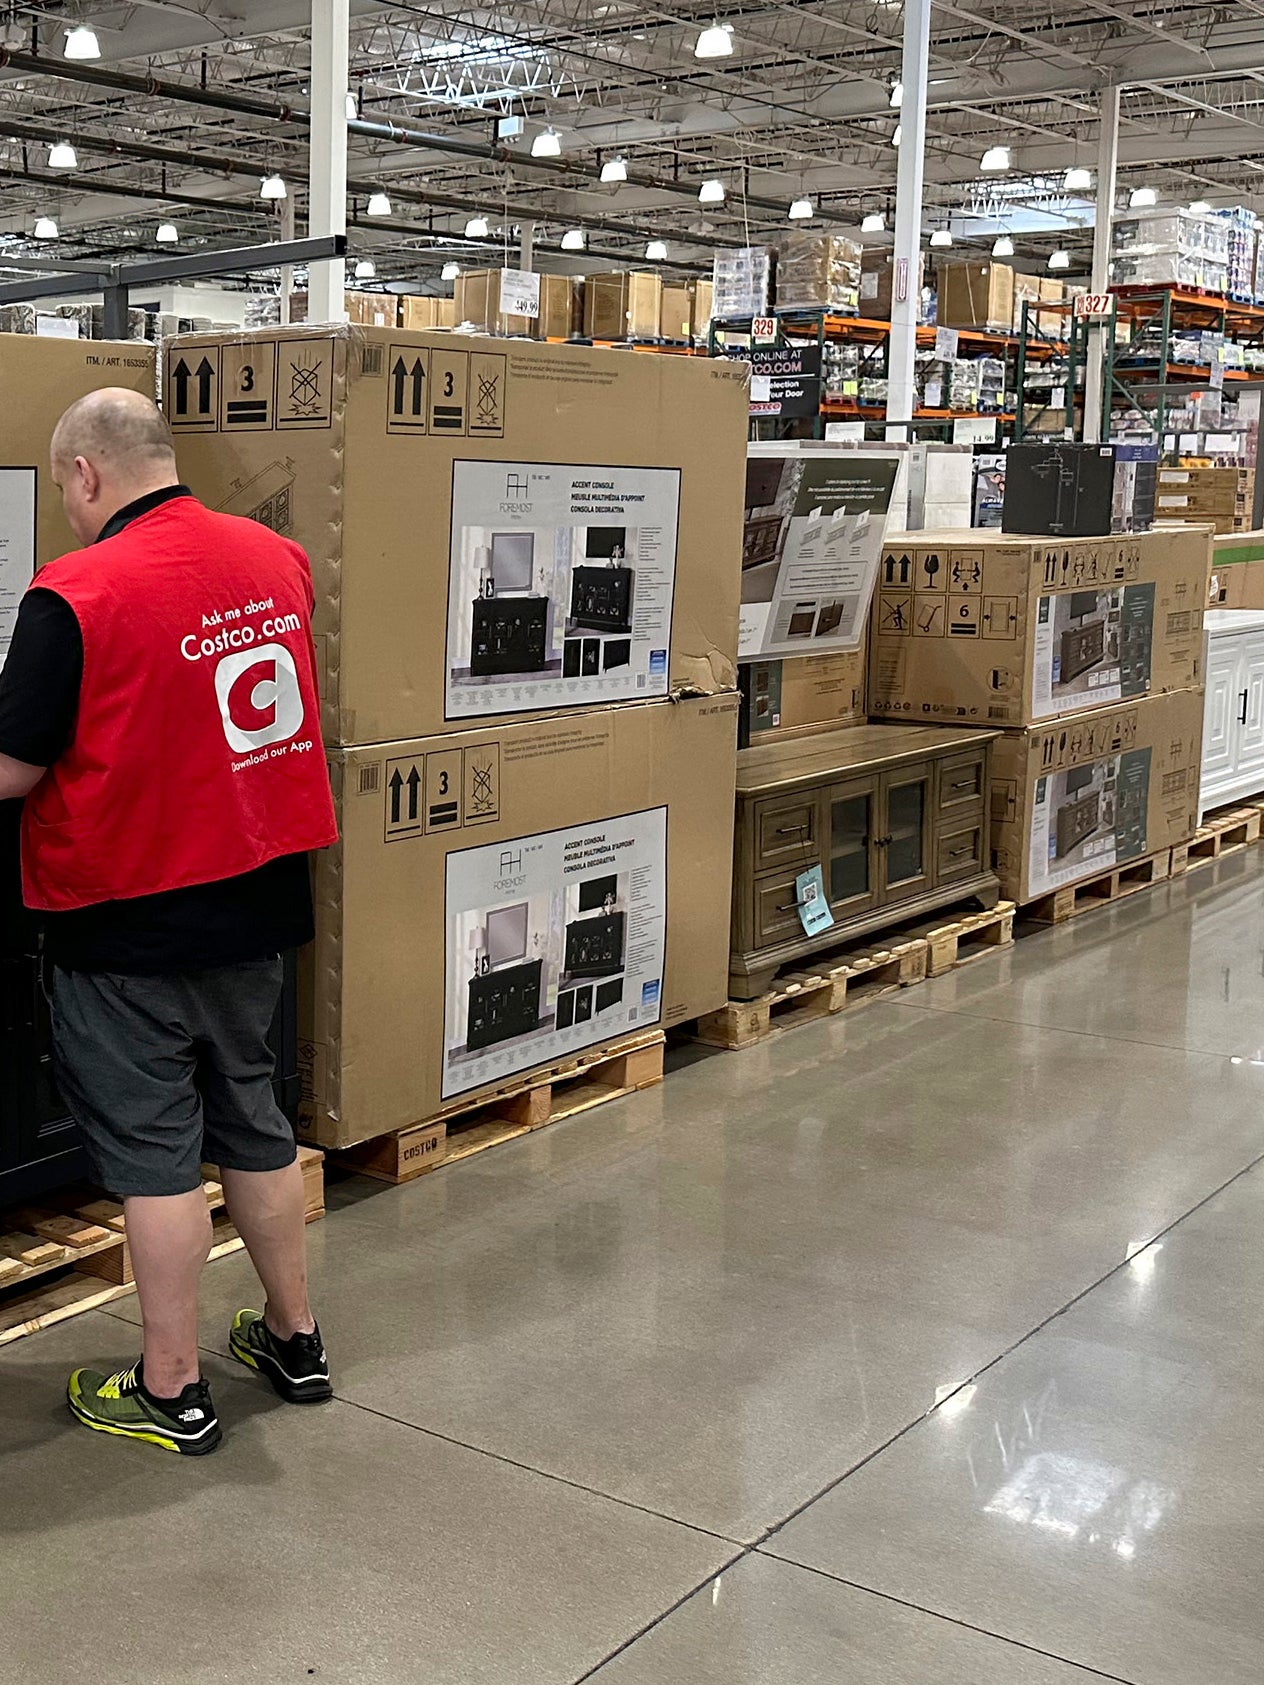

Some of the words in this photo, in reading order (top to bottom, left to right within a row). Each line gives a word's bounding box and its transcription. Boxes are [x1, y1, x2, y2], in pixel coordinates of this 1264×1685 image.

[1086, 295, 1109, 313] 327
[754, 319, 774, 336] 329
[753, 351, 788, 361] ONLINE
[790, 350, 803, 359] AT
[750, 361, 802, 374] TCO.COM
[240, 365, 254, 392] 3
[444, 371, 455, 397] 3
[769, 380, 800, 388] election
[770, 390, 784, 398] our
[785, 389, 804, 398] Door
[748, 402, 781, 411] OSTCO
[572, 481, 591, 489] ACCENT
[571, 493, 590, 501] MEUBLE
[499, 502, 533, 513] FOREMOST
[571, 505, 594, 513] CONSOLA
[595, 505, 625, 513] DECORATIVA
[201, 609, 223, 629] Ask
[225, 608, 241, 621] me
[244, 597, 274, 615] about
[958, 604, 969, 618] 6
[180, 613, 301, 661] Costco.com
[231, 750, 269, 773] Download
[270, 746, 287, 758] our
[290, 739, 313, 754] App
[439, 770, 449, 796] 3
[564, 838, 583, 851] ACCENT
[563, 861, 586, 874] CONSOLA
[403, 1137, 437, 1161] COSTCO
